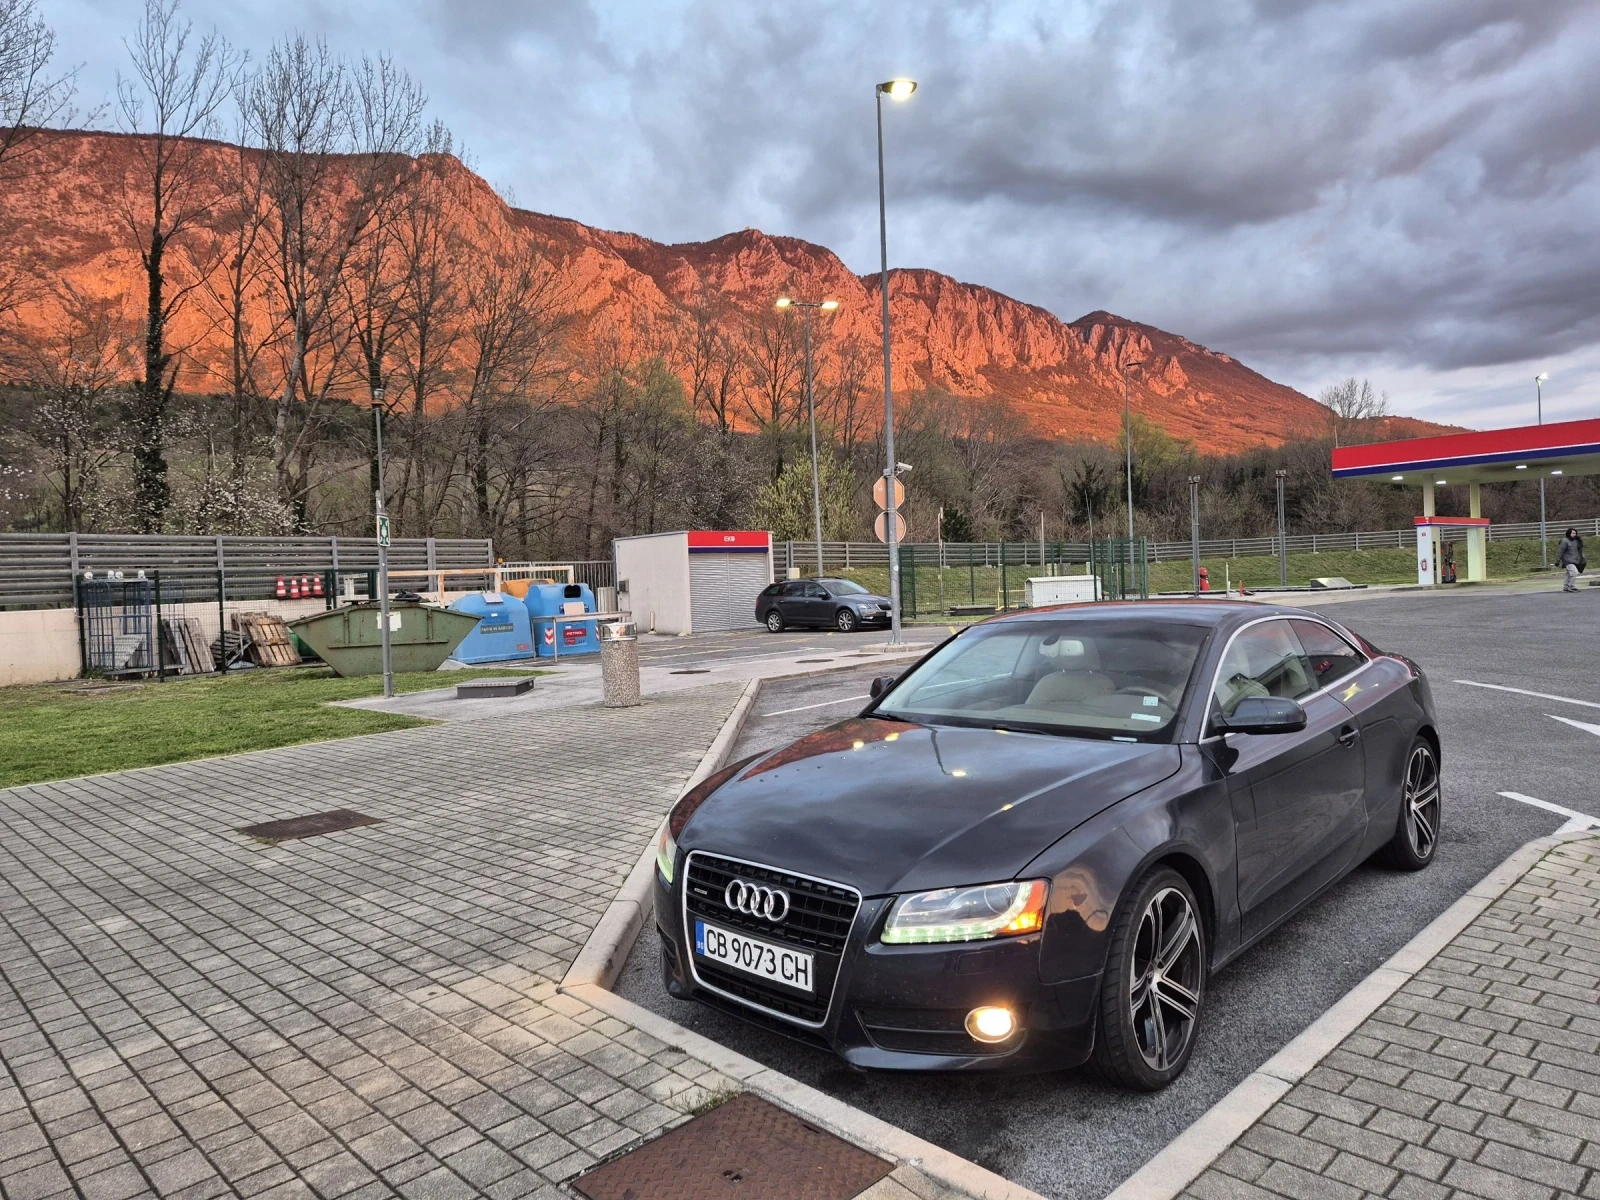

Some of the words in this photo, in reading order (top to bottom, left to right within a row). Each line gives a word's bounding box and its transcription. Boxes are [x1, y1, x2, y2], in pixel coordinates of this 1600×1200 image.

[706, 929, 728, 958] CB
[731, 938, 777, 975] 9073
[781, 953, 808, 986] CH
